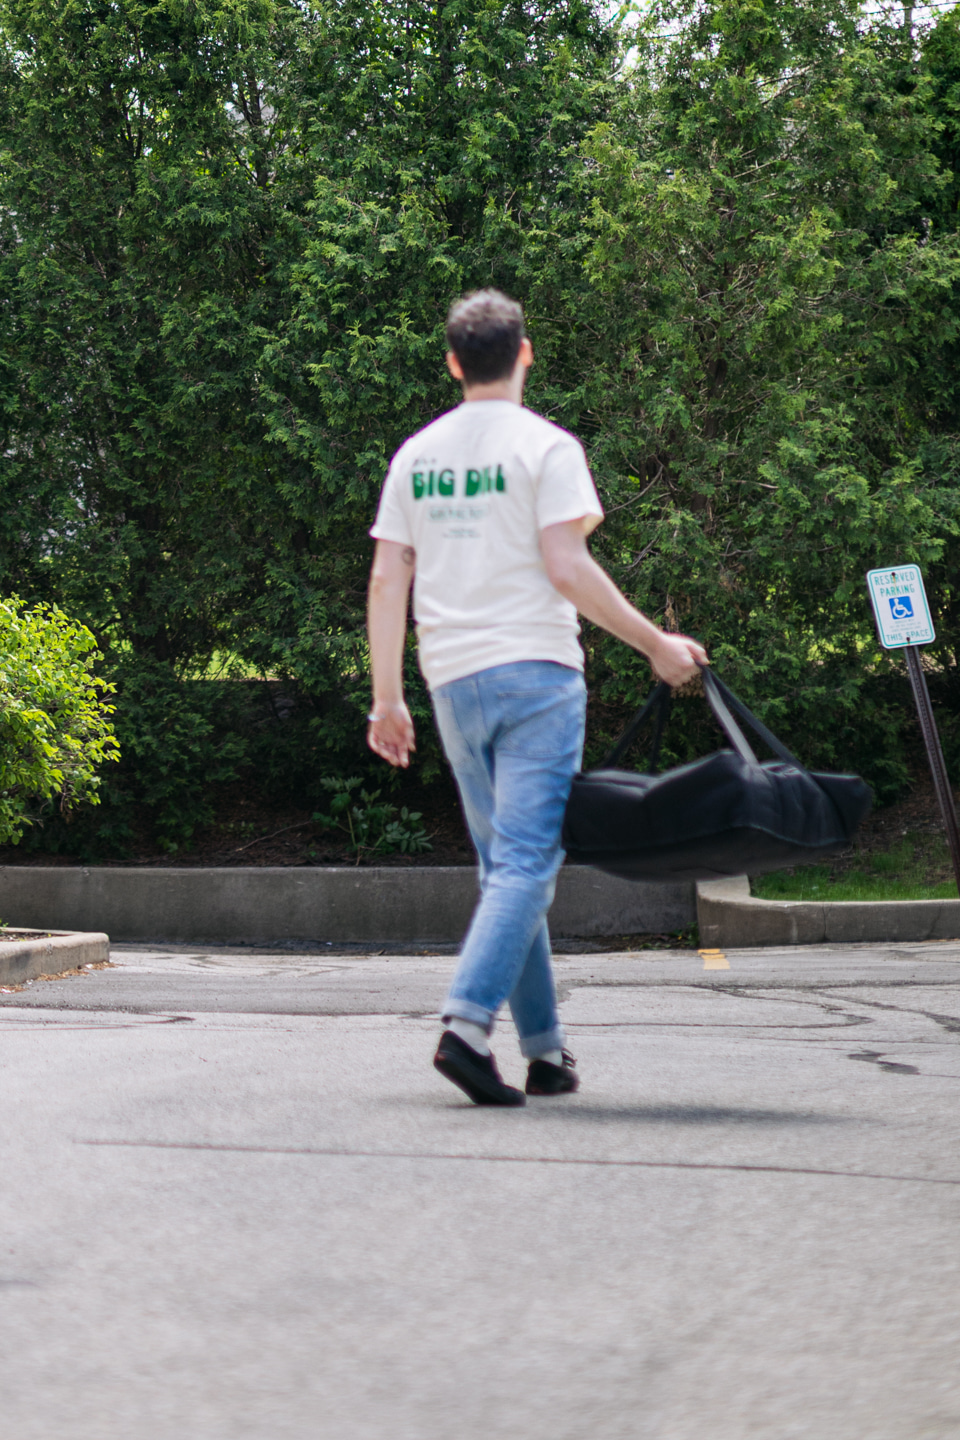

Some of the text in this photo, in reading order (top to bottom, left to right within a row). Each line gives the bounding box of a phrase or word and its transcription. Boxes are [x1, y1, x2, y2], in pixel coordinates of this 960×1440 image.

[411, 468, 455, 500] BIG
[874, 572, 915, 586] RESERVED
[879, 584, 916, 597] PARKING
[886, 633, 903, 642] THIS
[905, 629, 929, 638] SPACE
